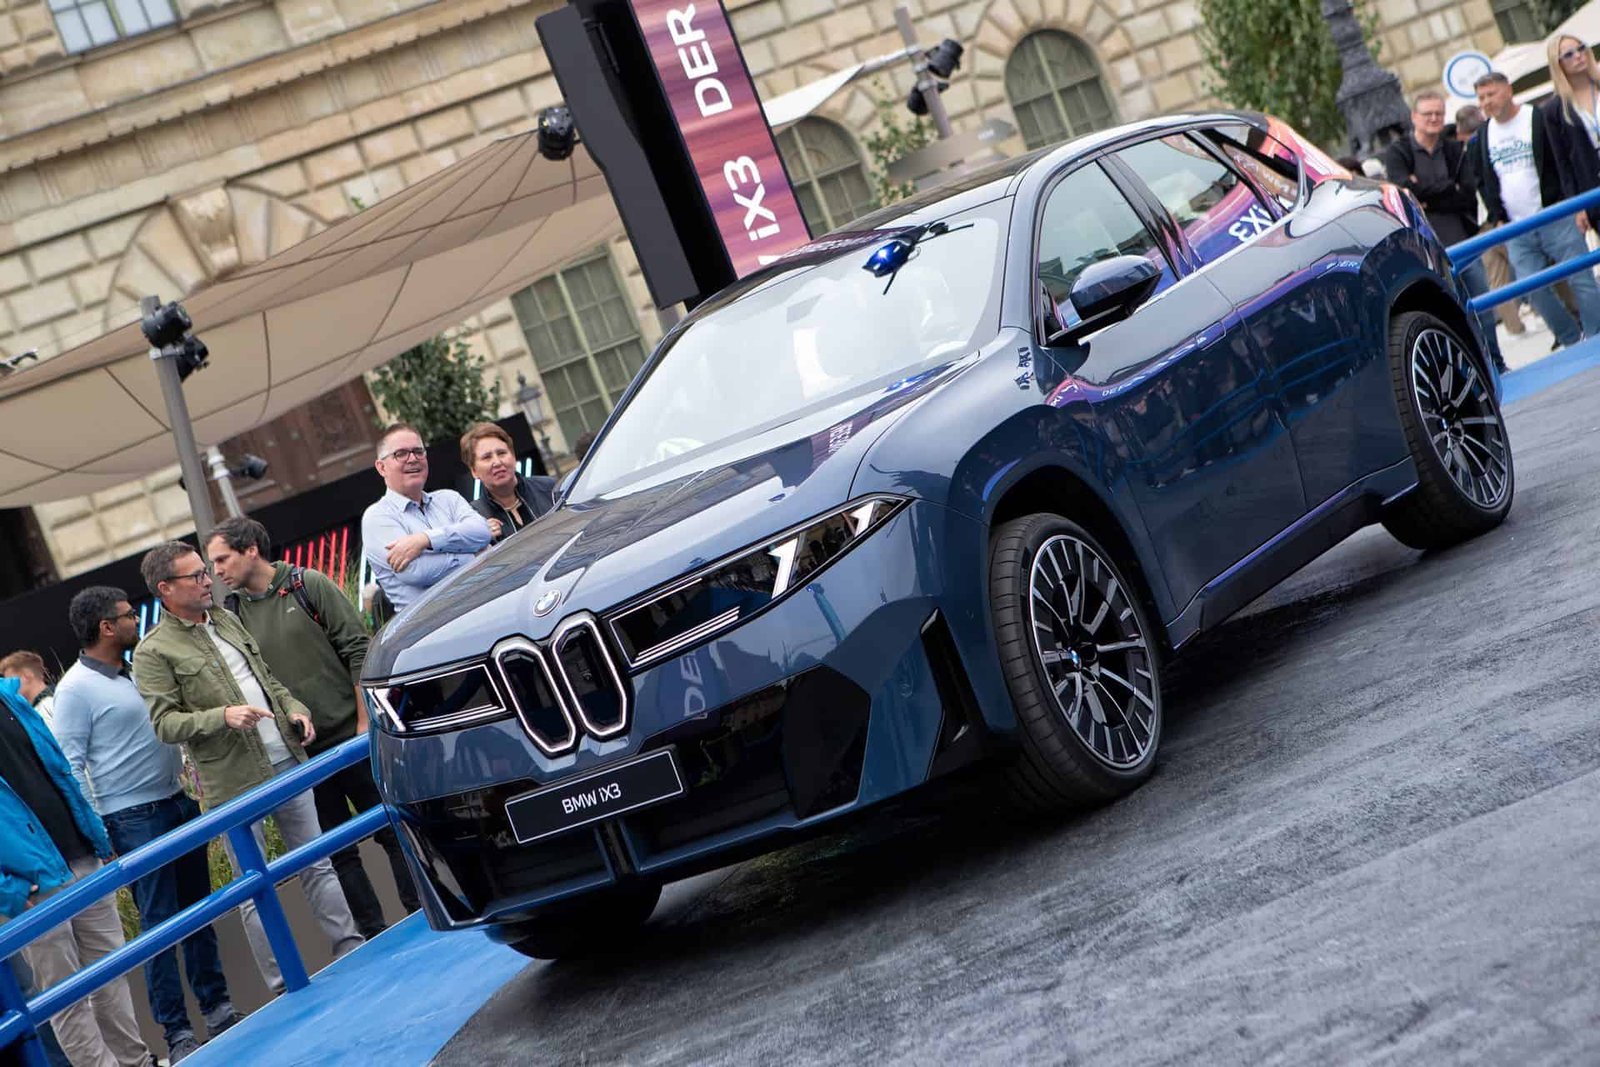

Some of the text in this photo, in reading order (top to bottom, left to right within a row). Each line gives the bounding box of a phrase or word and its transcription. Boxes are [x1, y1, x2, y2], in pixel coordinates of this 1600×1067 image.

[666, 3, 781, 241] iX3 DER
[562, 782, 622, 814] BMW iX3
